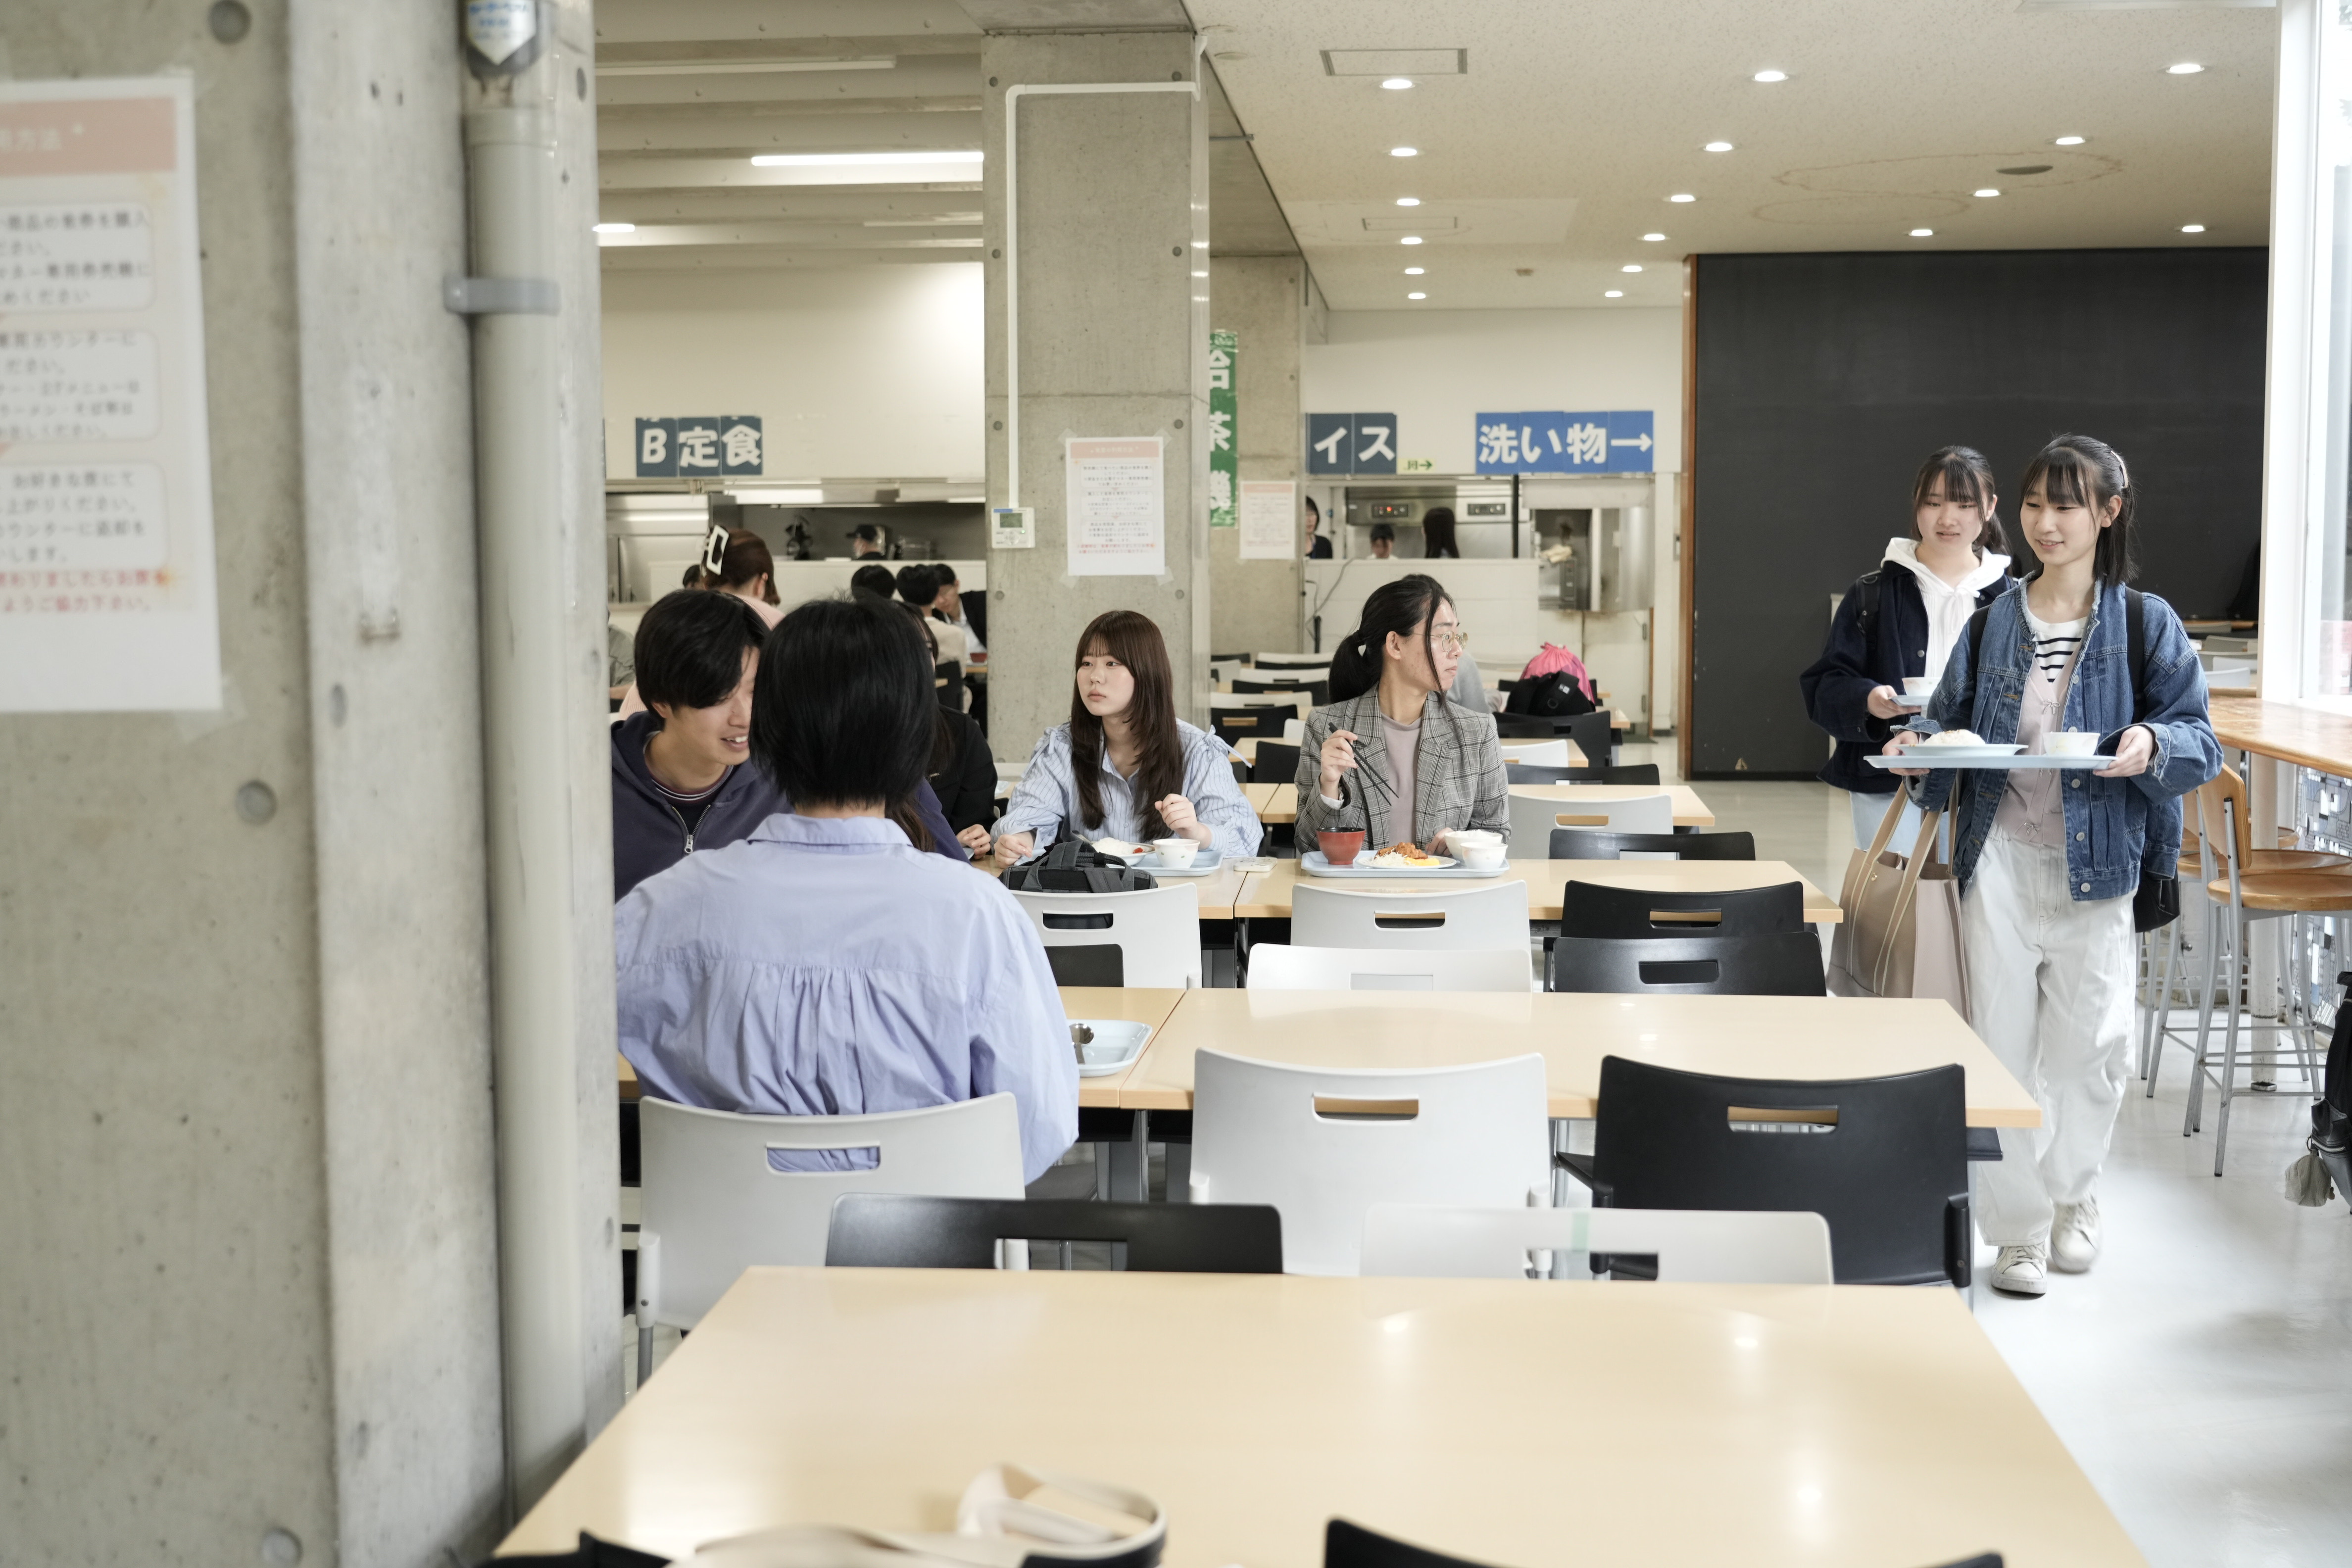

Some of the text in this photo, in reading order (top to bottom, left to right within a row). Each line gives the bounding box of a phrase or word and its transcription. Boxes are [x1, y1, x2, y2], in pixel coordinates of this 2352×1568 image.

[642, 424, 762, 468] B定食
[1314, 426, 1395, 464] イス
[1478, 423, 1607, 465] 洗い物
